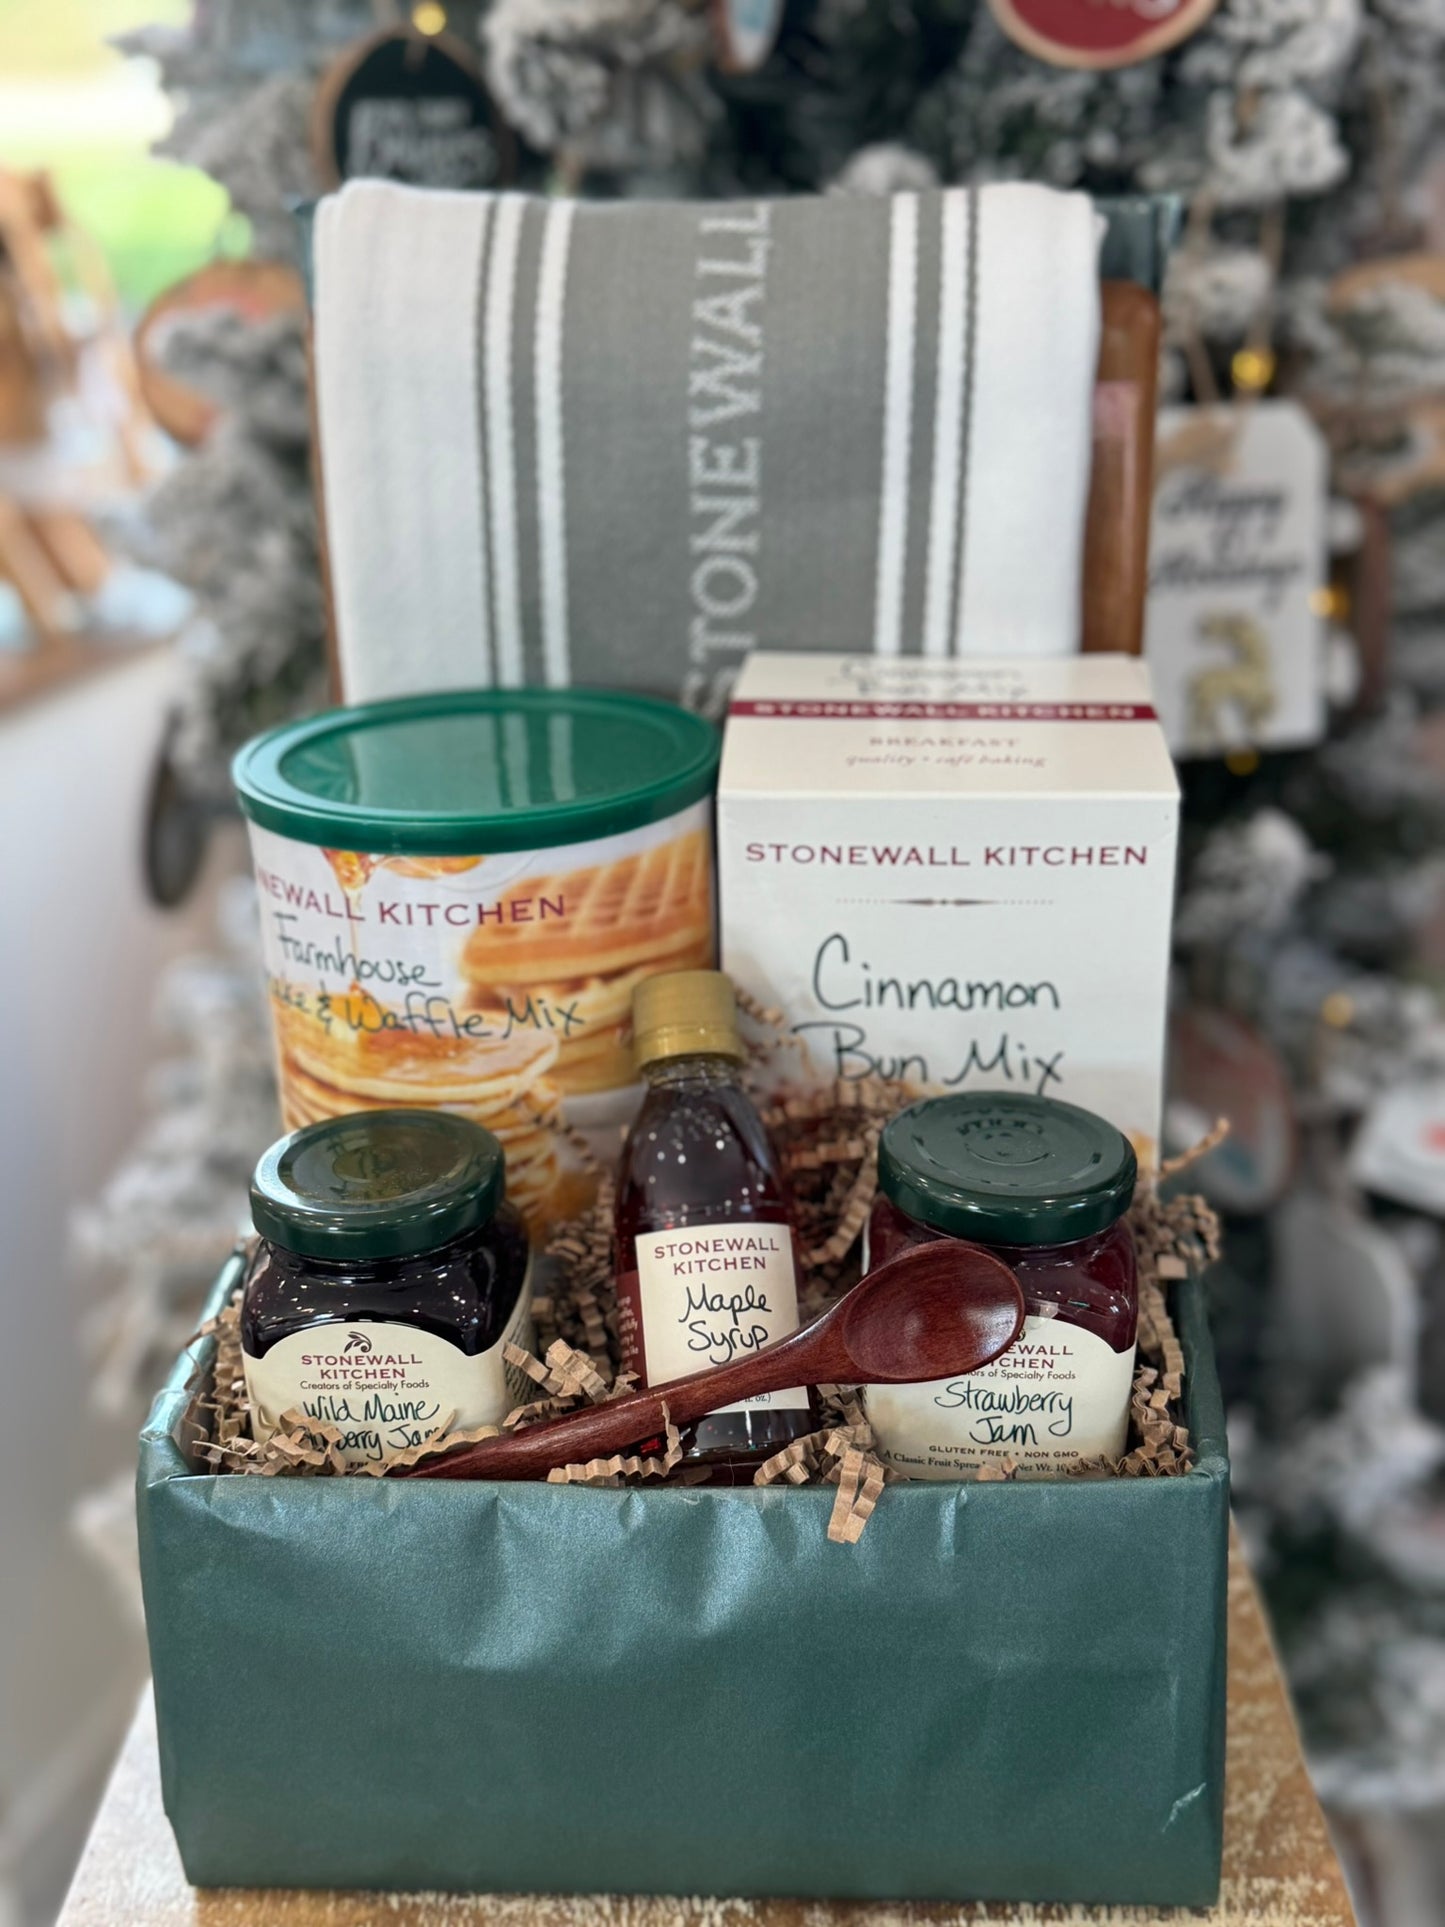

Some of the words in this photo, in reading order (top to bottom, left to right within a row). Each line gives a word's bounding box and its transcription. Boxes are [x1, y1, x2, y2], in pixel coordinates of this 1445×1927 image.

[754, 702, 969, 719] STONEWALL
[977, 704, 1136, 720] KITCHEN
[746, 843, 970, 867] STONEWALL
[984, 846, 1147, 867] KITCHEN
[379, 895, 566, 926] KITCHEN
[273, 910, 443, 987] Farmhouse
[812, 932, 1060, 1011] Cinnamon
[345, 990, 493, 1040] Waffle
[502, 995, 587, 1040] Mix
[791, 1021, 928, 1085] Bun
[943, 1033, 1065, 1097] Mix
[654, 1237, 779, 1259] STONEWALL
[673, 1256, 767, 1276] KITCHEN
[678, 1282, 772, 1326] Maple
[687, 1320, 769, 1365] Syrup
[1007, 1344, 1074, 1356] EWALL
[301, 1354, 423, 1366] STONEWALL
[300, 1381, 340, 1390] Creators
[342, 1380, 352, 1390] of
[355, 1380, 398, 1392] Specialty
[401, 1379, 430, 1389] Foods
[320, 1368, 406, 1379] KITCHEN
[987, 1368, 998, 1377] of
[1001, 1369, 1045, 1381] Specialty
[1047, 1370, 1076, 1380] Foods
[303, 1395, 361, 1422] Wild
[364, 1392, 441, 1422] Maine
[934, 1381, 1073, 1437] Strawberry
[969, 1416, 1039, 1446] Jam
[894, 1452, 926, 1465] Classic
[928, 1457, 952, 1468] Fruit
[928, 1445, 976, 1455] GLUTEN
[980, 1448, 1009, 1457] FREE
[1053, 1450, 1079, 1458] GMO
